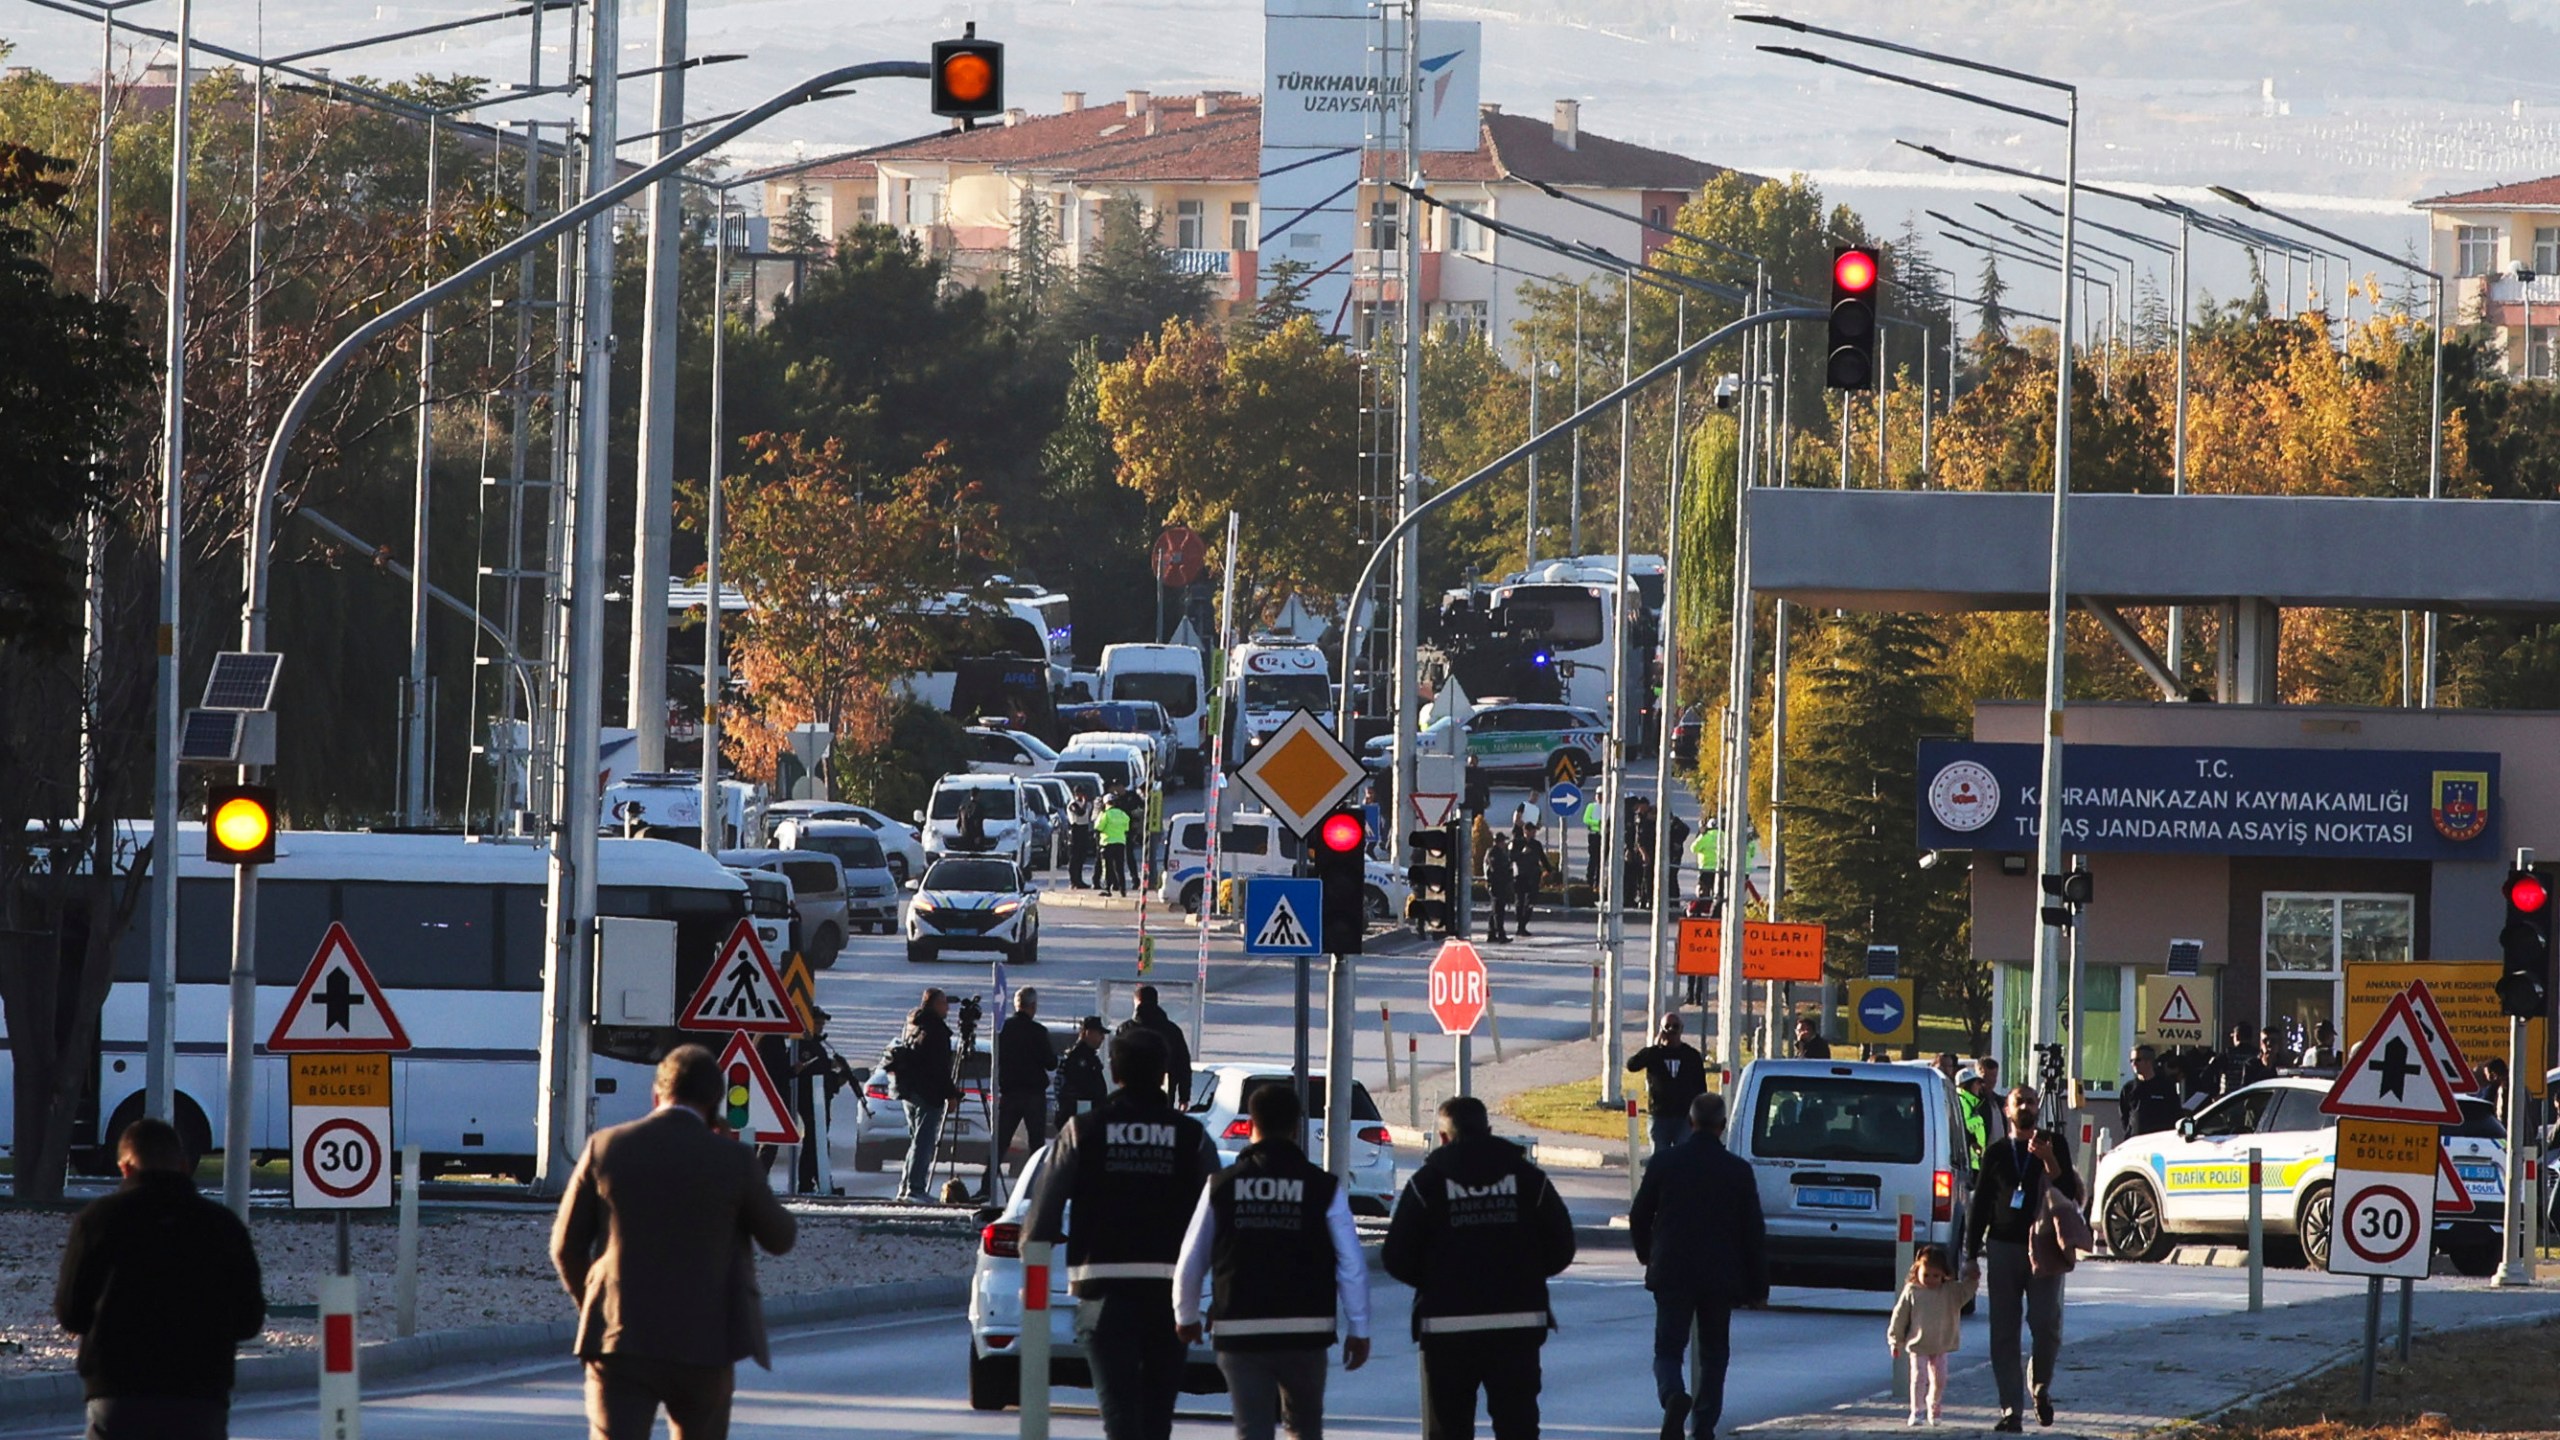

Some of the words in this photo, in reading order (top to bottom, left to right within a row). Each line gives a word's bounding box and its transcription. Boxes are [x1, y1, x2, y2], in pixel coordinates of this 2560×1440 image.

[2196, 759, 2234, 779] T.C.
[2021, 786, 2228, 809] KRAMANKAZAN
[2236, 789, 2409, 813] KAYMAKAMLIĞI
[2015, 816, 2090, 841] TUAŞ
[2096, 817, 2223, 840] JANDARMA
[2228, 819, 2308, 846] ASAYİŞ
[2315, 823, 2413, 844] NOKTASI
[1694, 928, 1810, 943] KAROLLARI
[1434, 971, 1481, 1005] DUR
[2157, 1028, 2203, 1040] YAVAŞ
[301, 1063, 348, 1076] AZAMİ
[356, 1064, 381, 1076] HIZ
[309, 1081, 372, 1096] BÖLGESİ
[1106, 1122, 1176, 1147] KOM
[2349, 1130, 2396, 1145] AZAMİ
[2405, 1135, 2429, 1148] HIZ
[321, 1140, 364, 1171] 30
[2357, 1147, 2420, 1163] BÖLGESİ
[2171, 1168, 2206, 1186] TRAFİK
[2209, 1167, 2243, 1185] POLİSİ
[1235, 1178, 1304, 1202] KOM
[2359, 1207, 2404, 1240] 30
